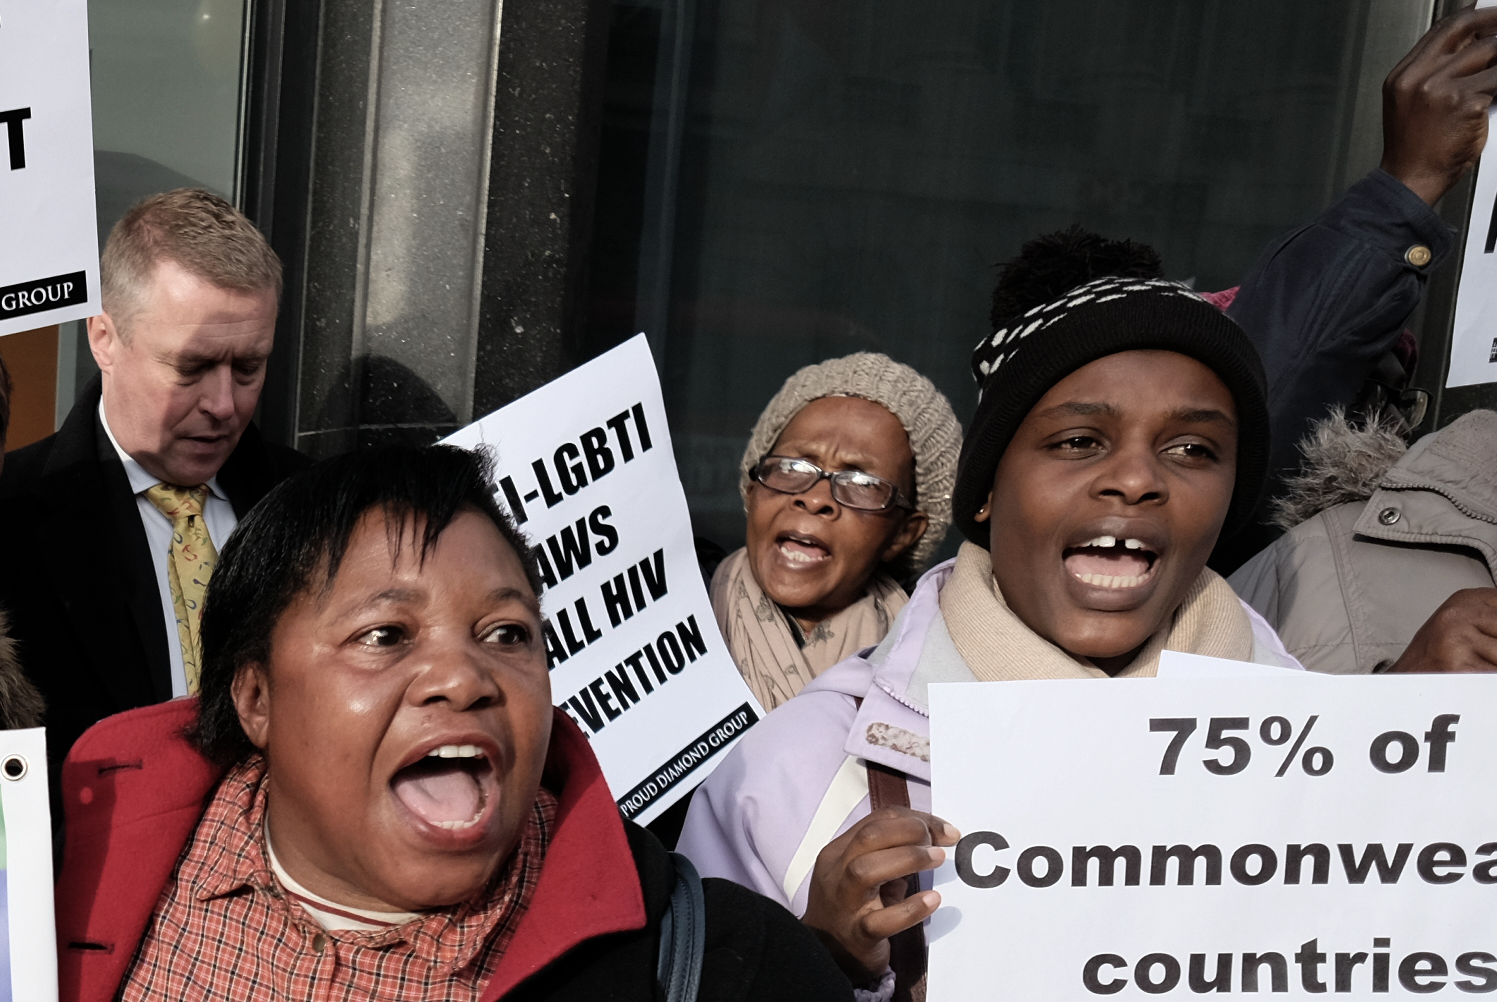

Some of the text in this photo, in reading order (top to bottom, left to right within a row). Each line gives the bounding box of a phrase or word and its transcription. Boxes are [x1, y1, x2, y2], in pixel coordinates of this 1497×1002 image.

[0, 281, 75, 312] GROUP
[493, 401, 653, 526] I-LGBTI
[531, 505, 620, 590] AWS
[600, 547, 669, 630] HIV
[620, 710, 750, 818] PROUD DIAMOND GROUP
[1148, 713, 1461, 778] 75% of
[1082, 937, 1497, 995] countries
